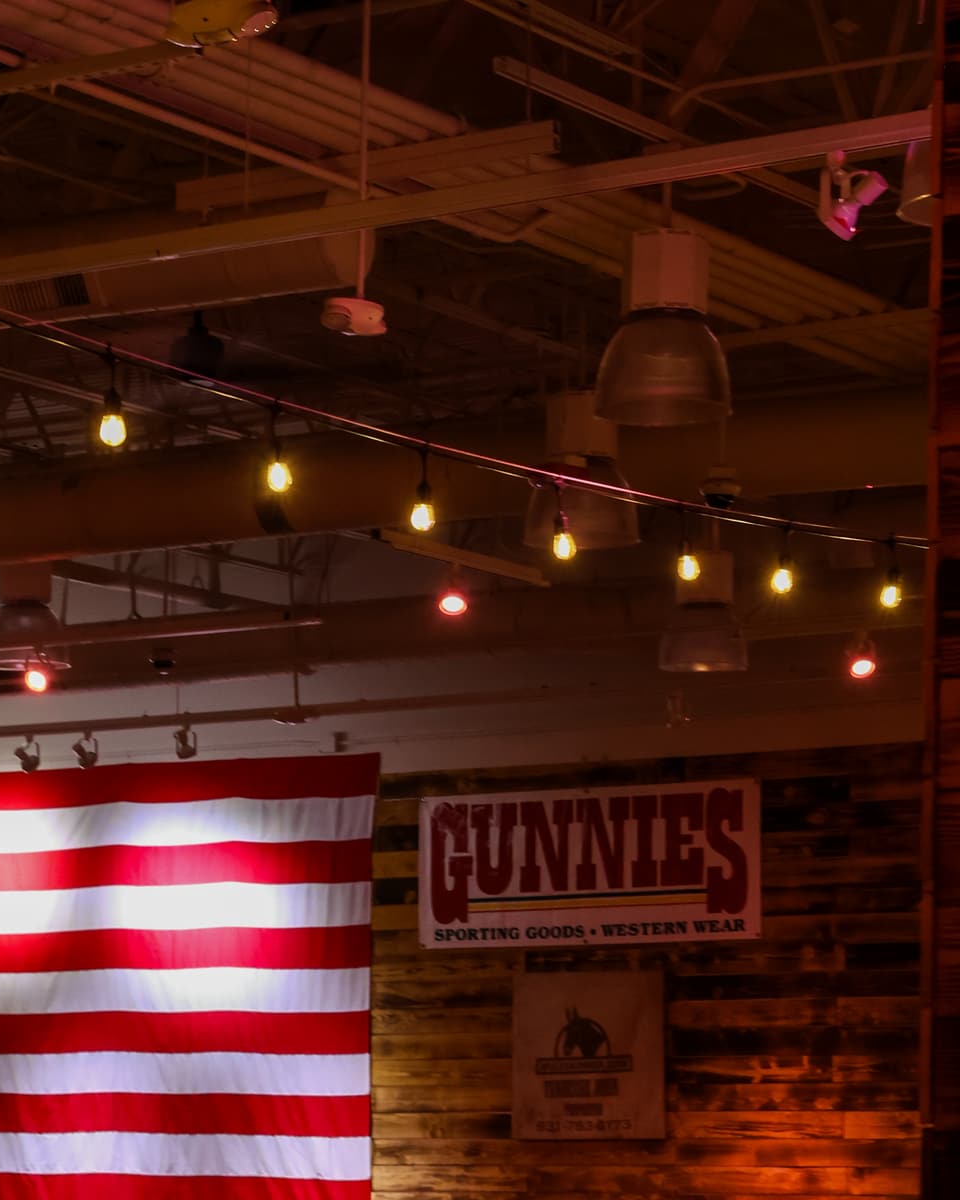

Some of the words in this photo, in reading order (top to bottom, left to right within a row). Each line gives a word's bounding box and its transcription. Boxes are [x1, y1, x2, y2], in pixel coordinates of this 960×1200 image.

[431, 788, 747, 924] GUNNIES
[434, 927, 520, 941] SPORTING
[526, 925, 585, 940] GOODS
[601, 922, 688, 936] WESTERN
[694, 919, 746, 934] WEAR
